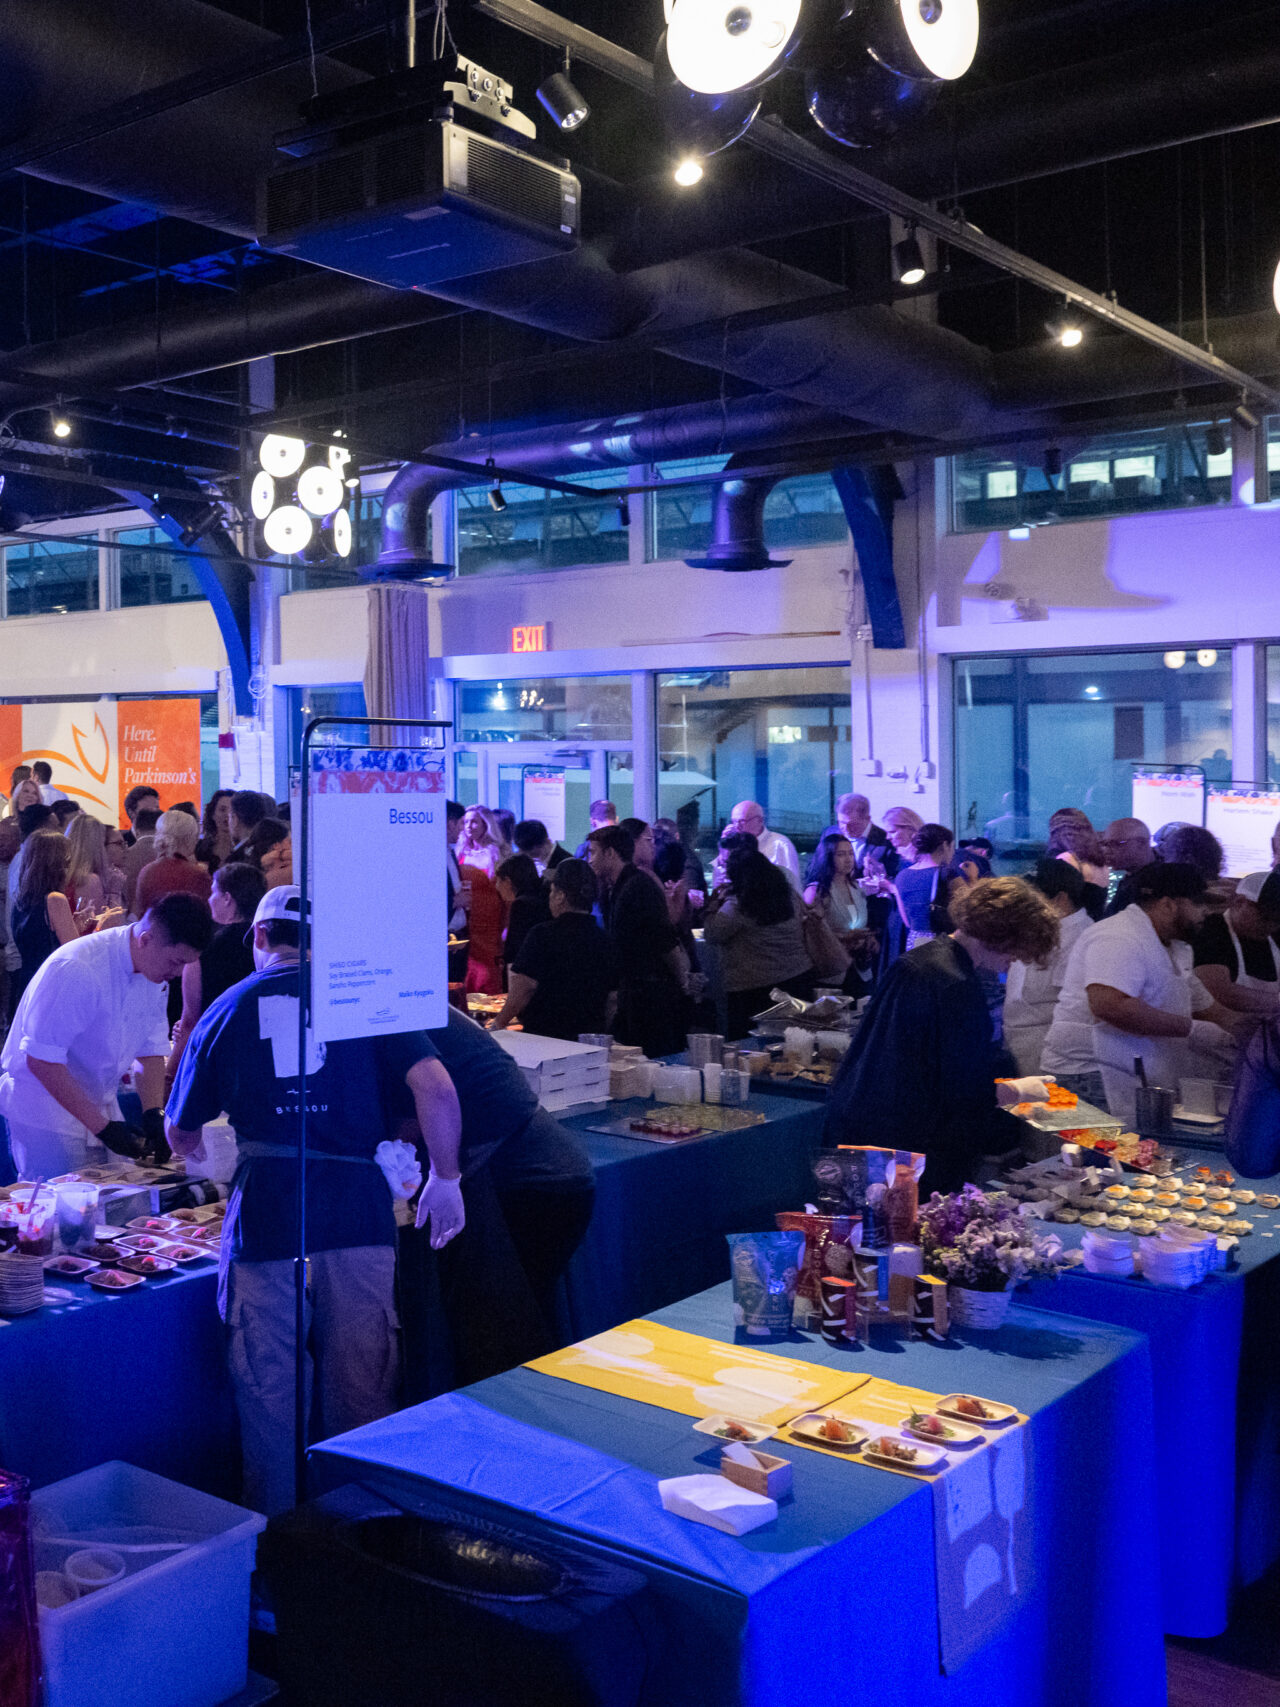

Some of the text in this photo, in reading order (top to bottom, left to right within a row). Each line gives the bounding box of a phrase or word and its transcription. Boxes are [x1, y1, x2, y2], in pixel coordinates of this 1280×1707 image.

[512, 626, 545, 653] EXIT
[123, 725, 157, 741] Here.
[124, 745, 157, 763] Until
[124, 767, 197, 784] Parkinson's
[389, 808, 434, 824] Bessou
